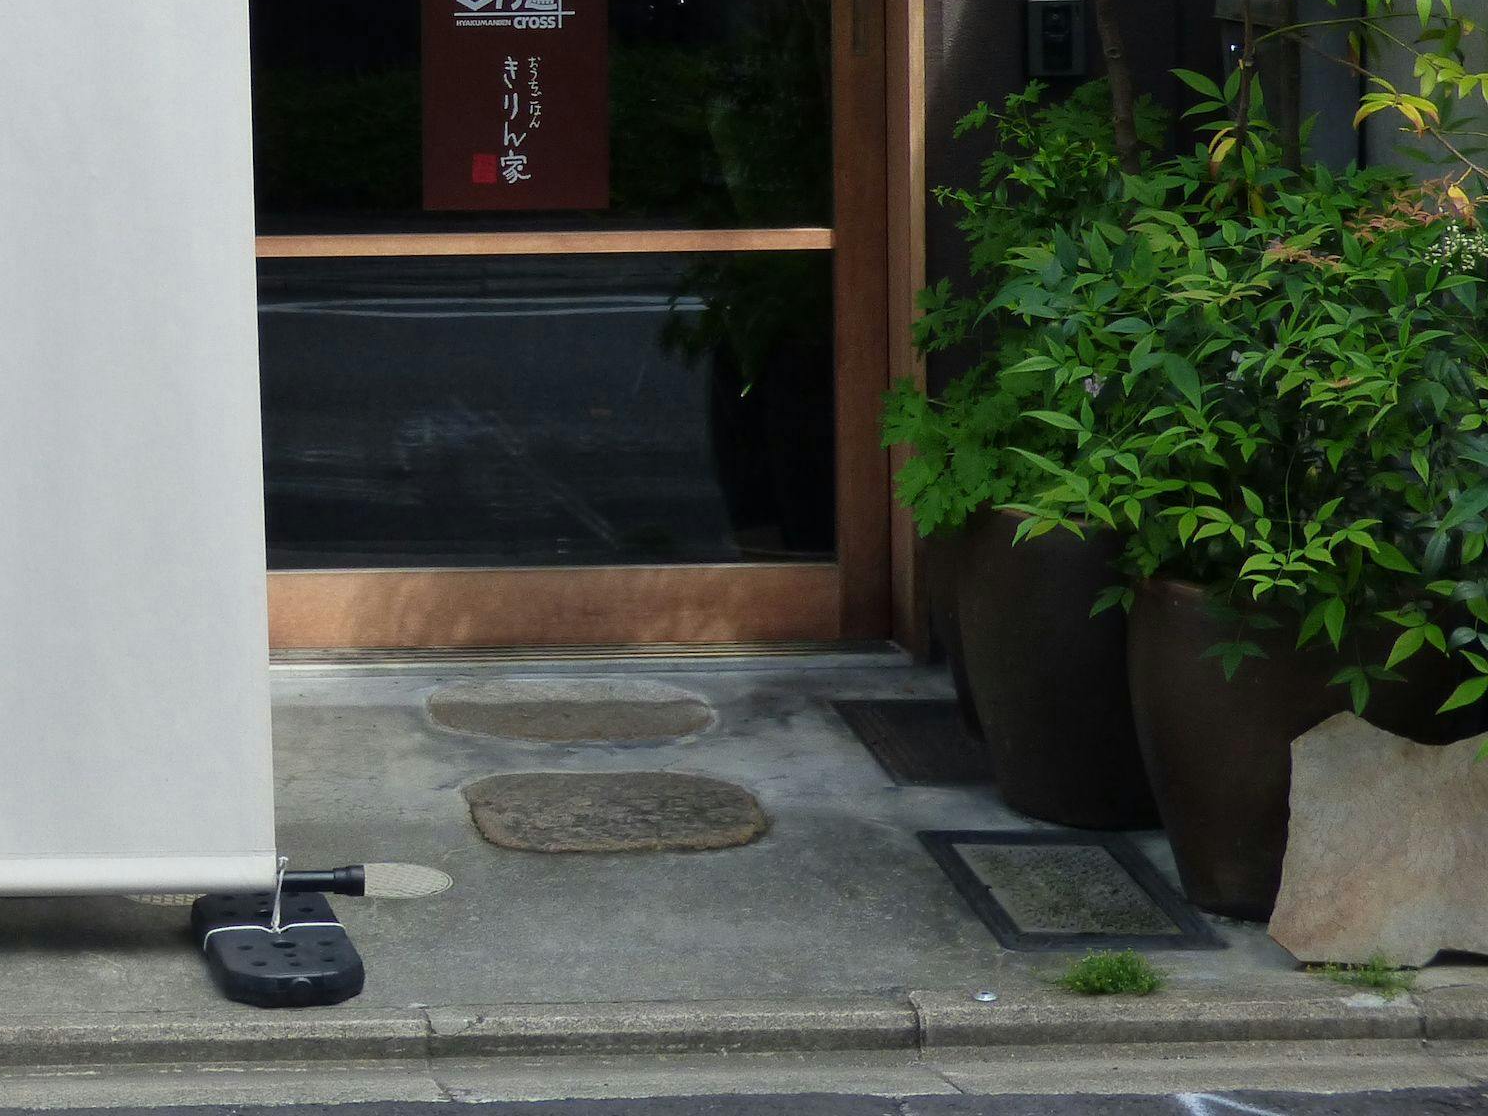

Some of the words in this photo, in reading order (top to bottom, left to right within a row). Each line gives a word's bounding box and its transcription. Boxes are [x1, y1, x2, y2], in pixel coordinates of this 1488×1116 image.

[513, 16, 556, 30] cross
[500, 56, 531, 184] きりん家
